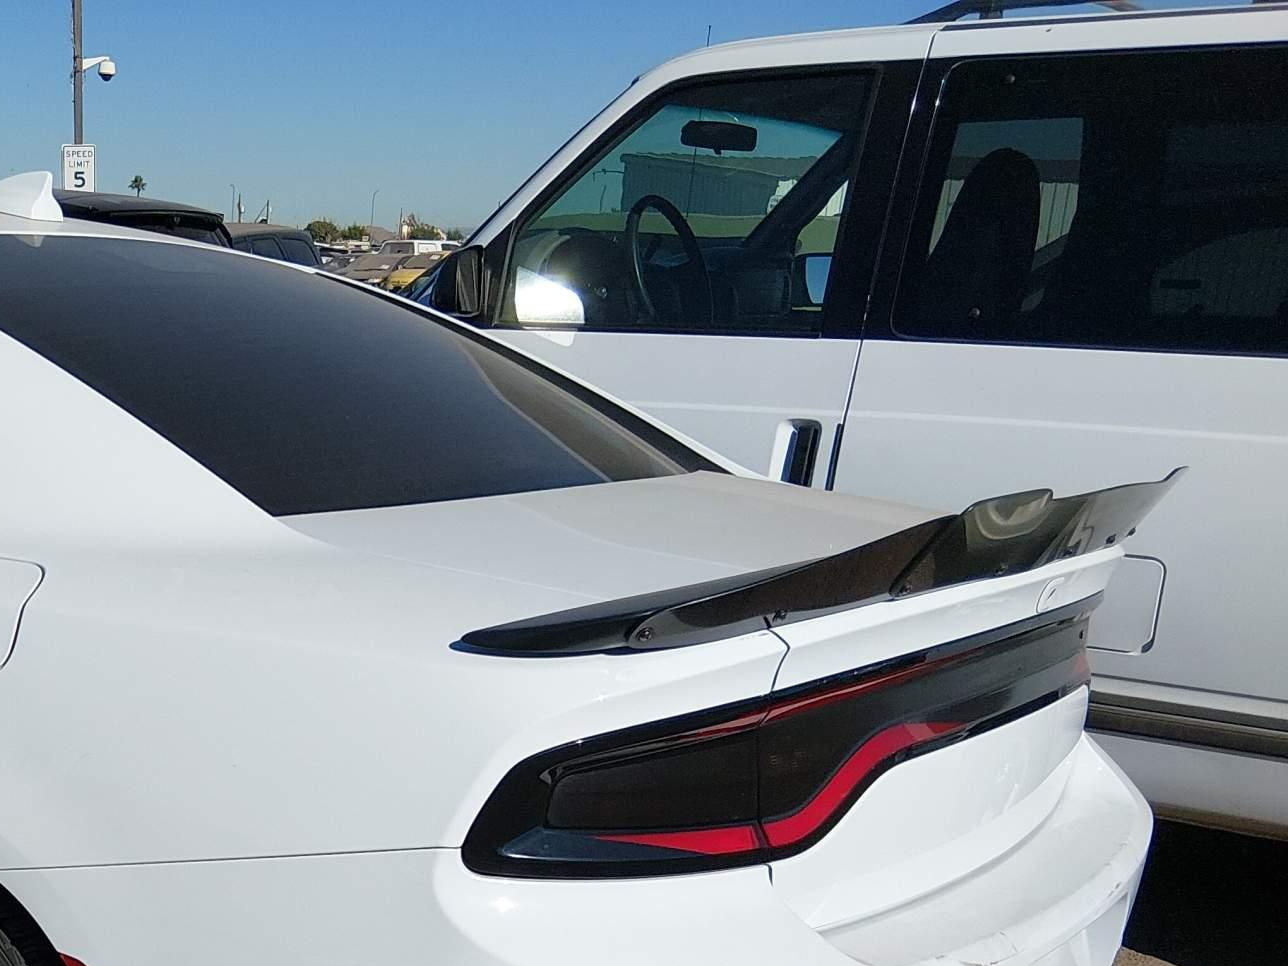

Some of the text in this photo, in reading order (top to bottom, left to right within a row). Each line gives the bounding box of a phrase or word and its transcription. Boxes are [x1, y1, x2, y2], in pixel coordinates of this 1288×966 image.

[65, 150, 93, 158] SPEED
[68, 160, 90, 168] LIMIT
[74, 171, 86, 188] 5
